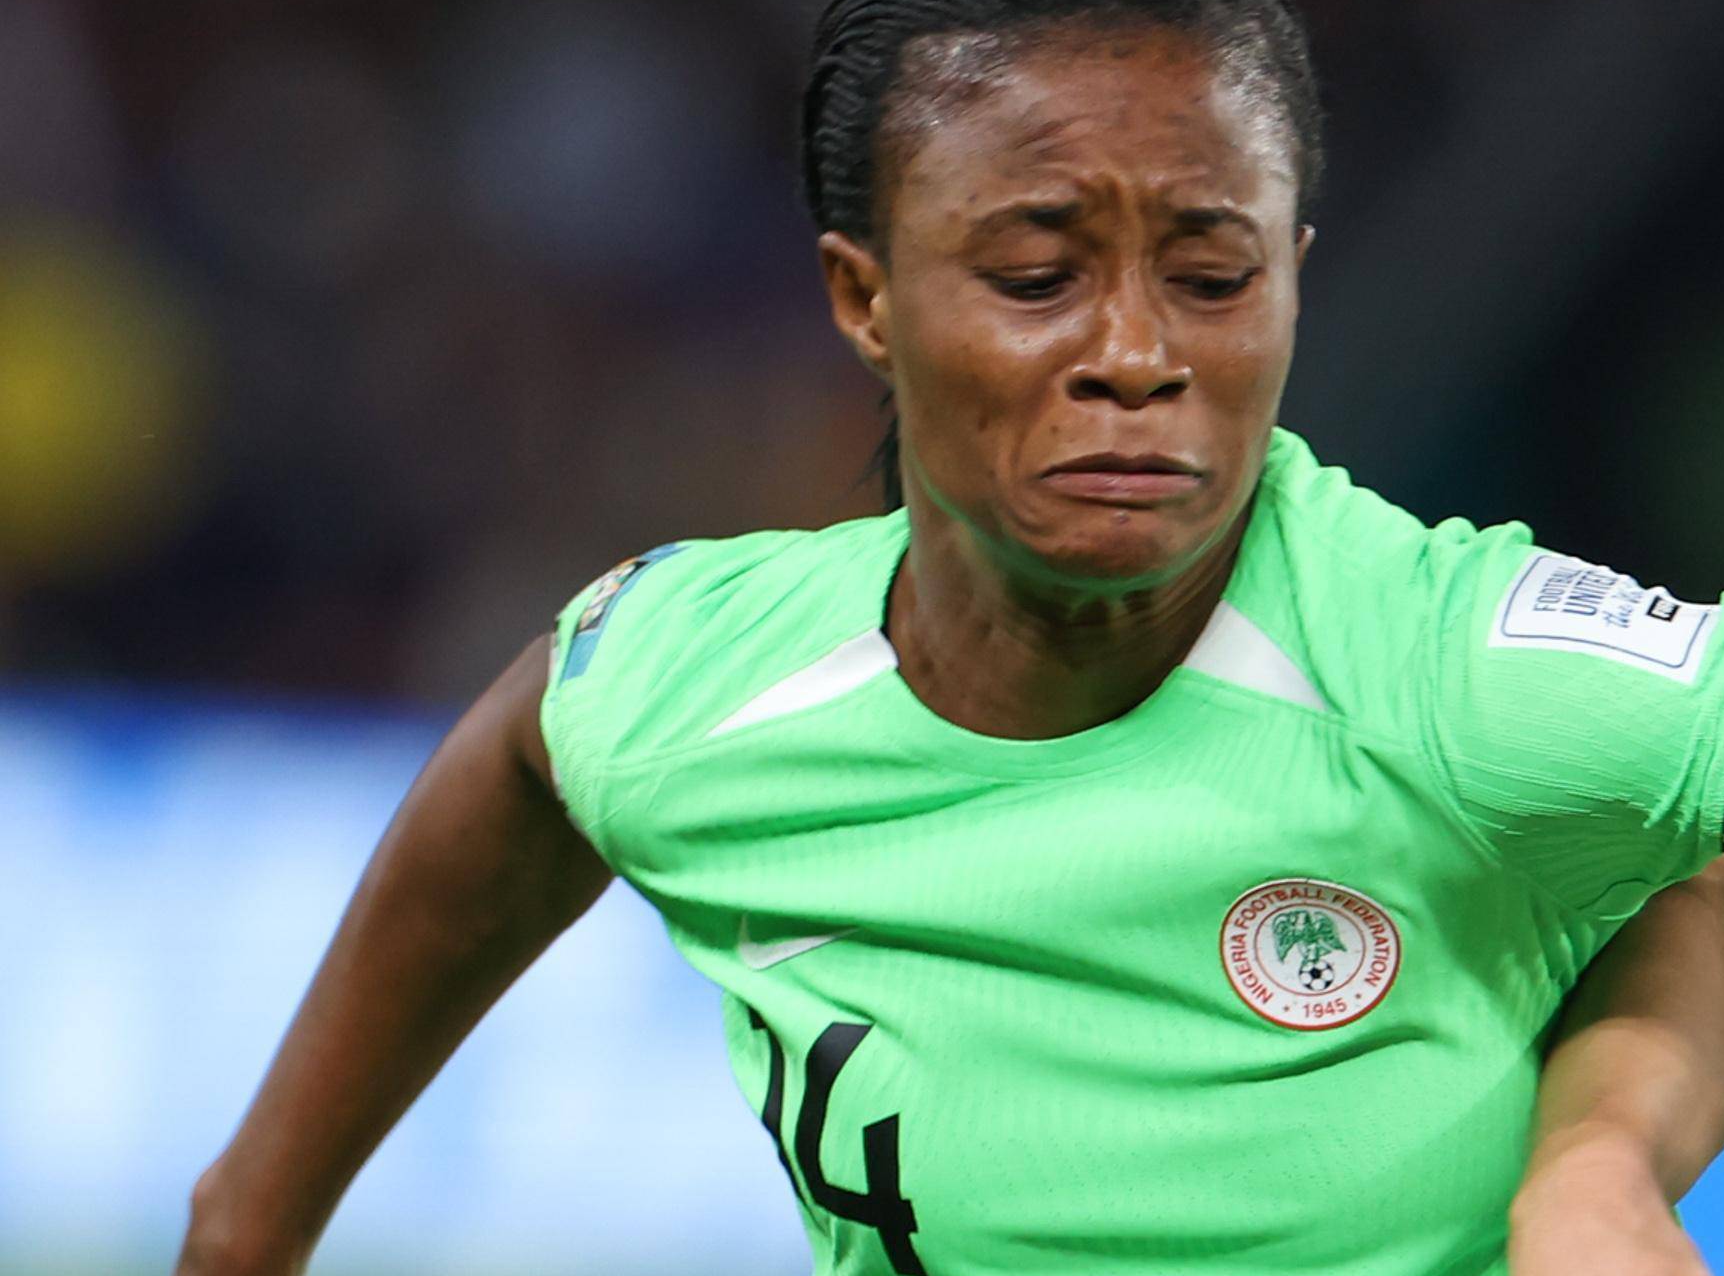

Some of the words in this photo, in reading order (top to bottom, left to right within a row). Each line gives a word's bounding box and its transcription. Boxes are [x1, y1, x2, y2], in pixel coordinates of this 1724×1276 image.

[1234, 886, 1330, 932] FOOTBALL
[1230, 933, 1274, 1006] NIGERIA
[1331, 892, 1390, 988] FEDERATION
[1303, 997, 1347, 1019] 1945
